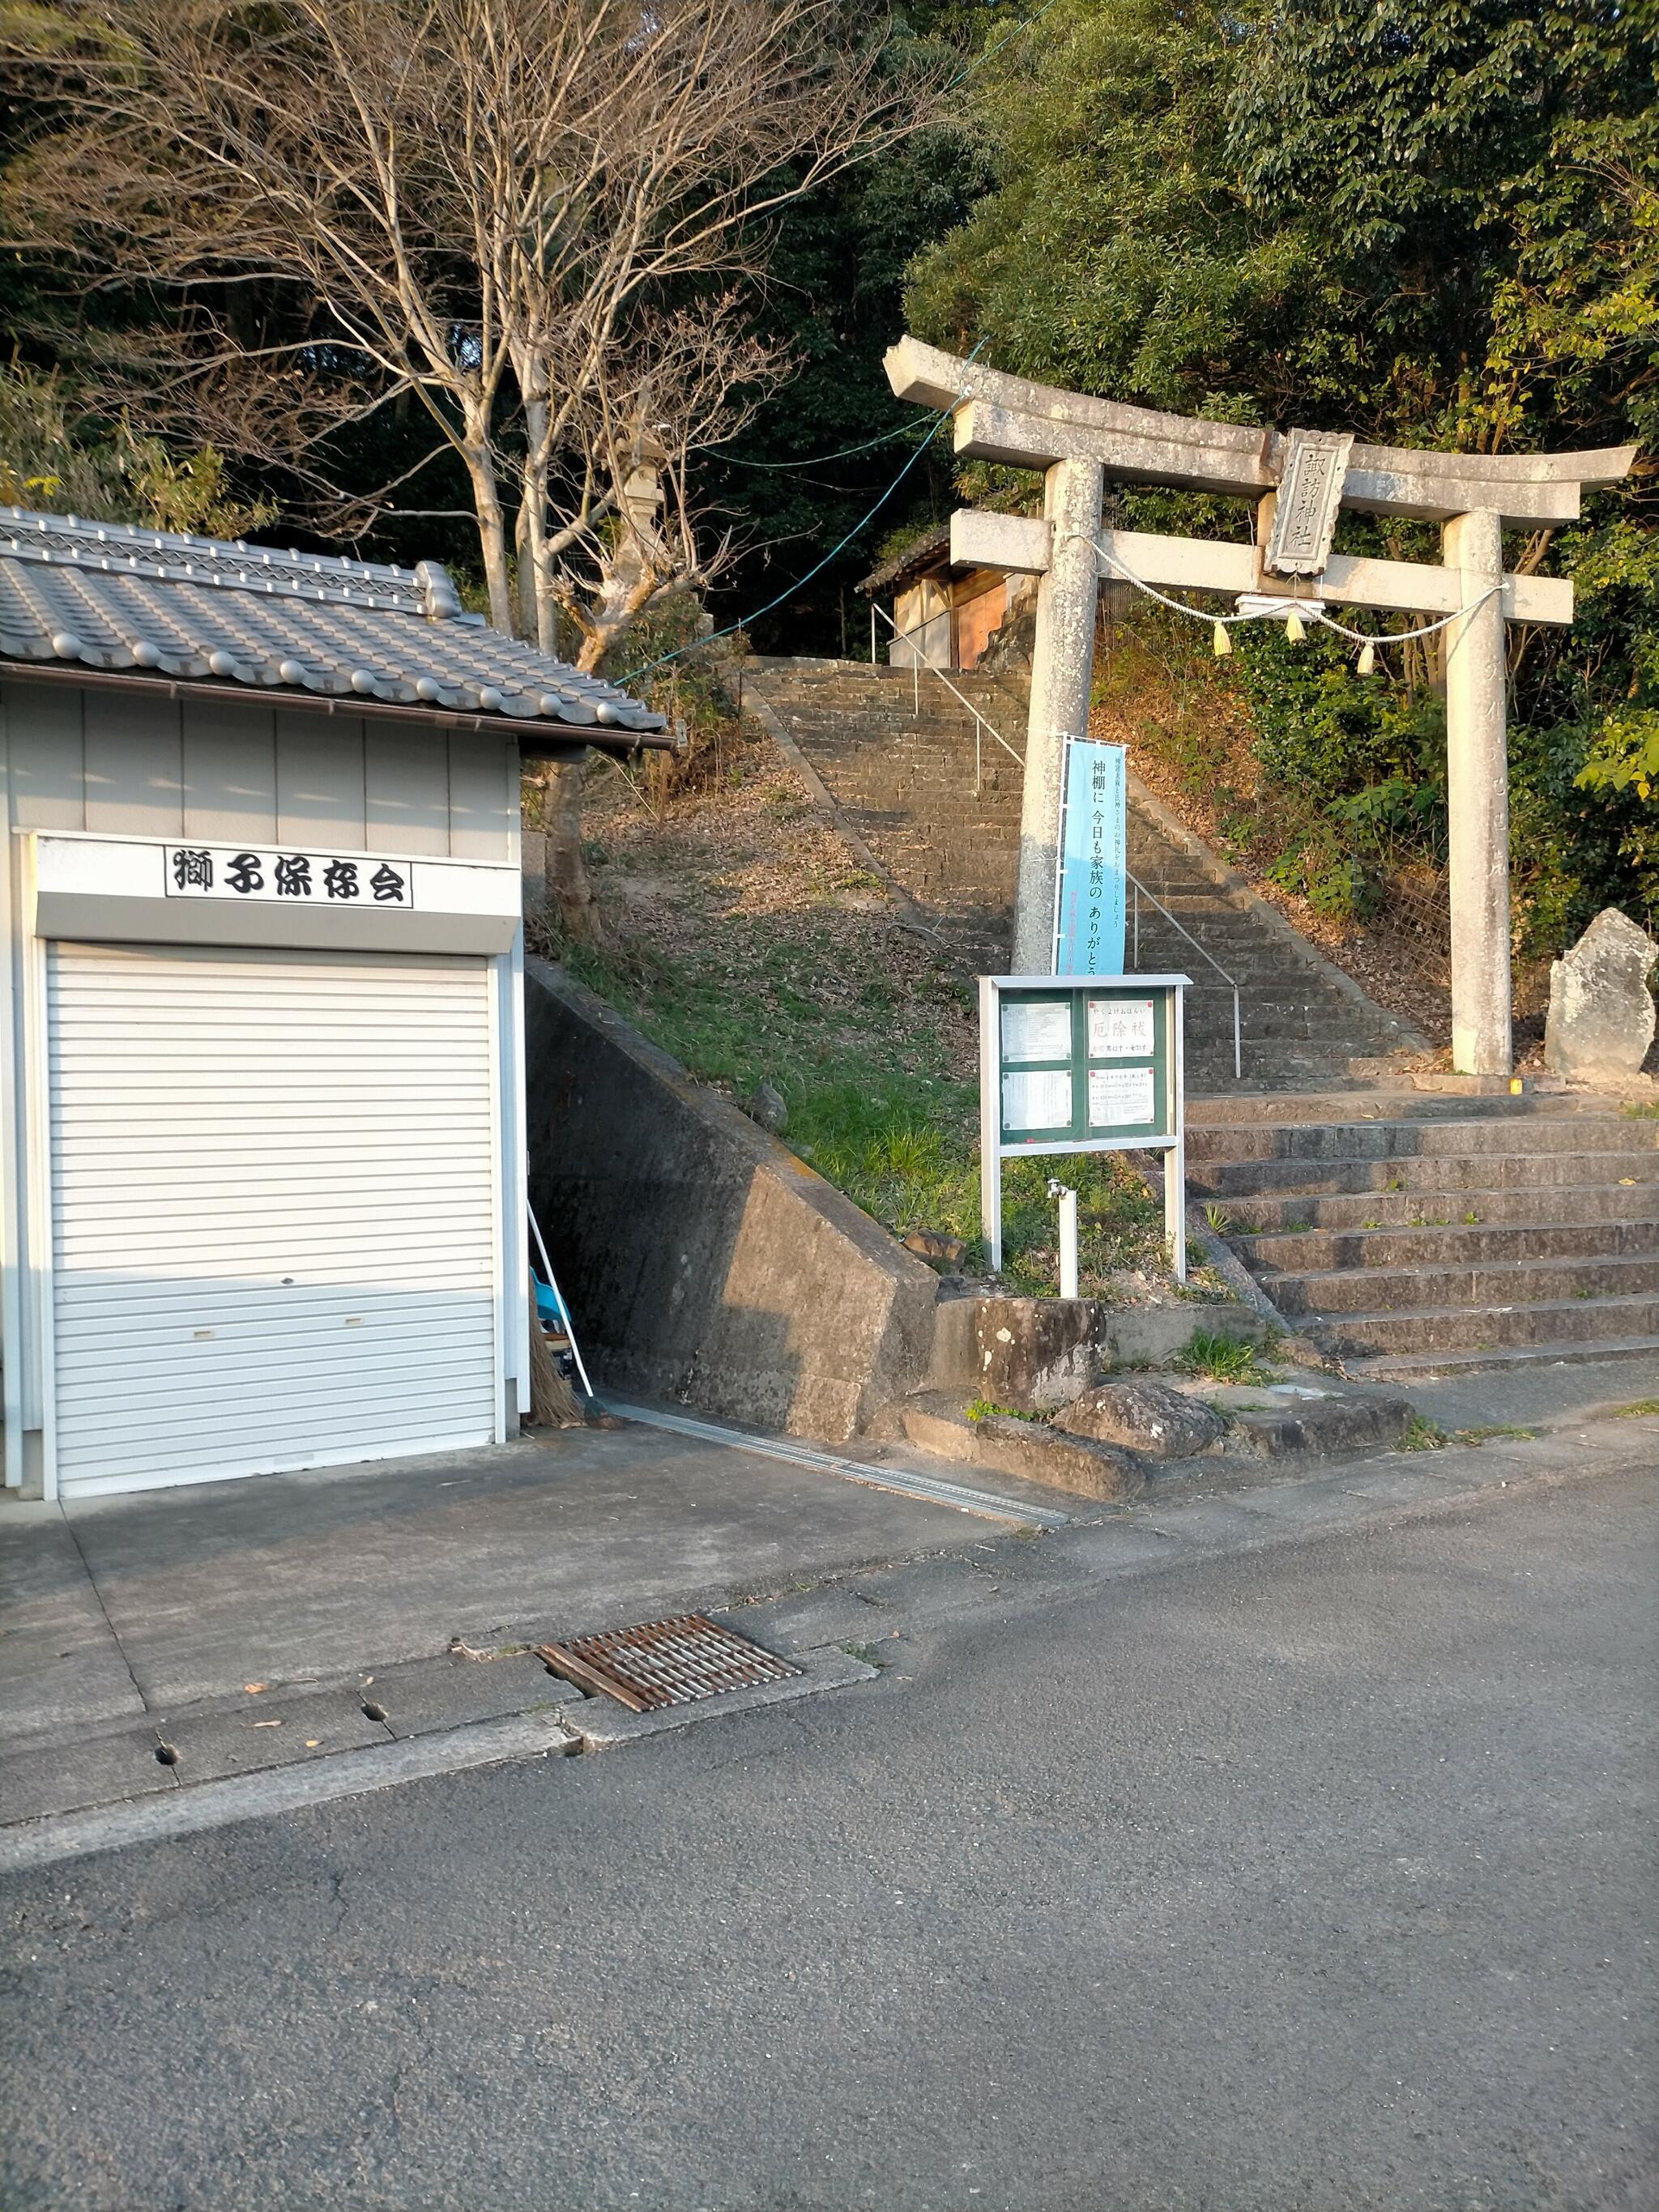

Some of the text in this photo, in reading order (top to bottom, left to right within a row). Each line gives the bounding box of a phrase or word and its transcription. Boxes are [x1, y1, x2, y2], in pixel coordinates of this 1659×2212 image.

[1290, 454, 1325, 546] 諏訪神社
[1091, 761, 1106, 804] 神棚に
[173, 850, 404, 901] 獅子保存会
[1090, 809, 1105, 899] 今日も家族の
